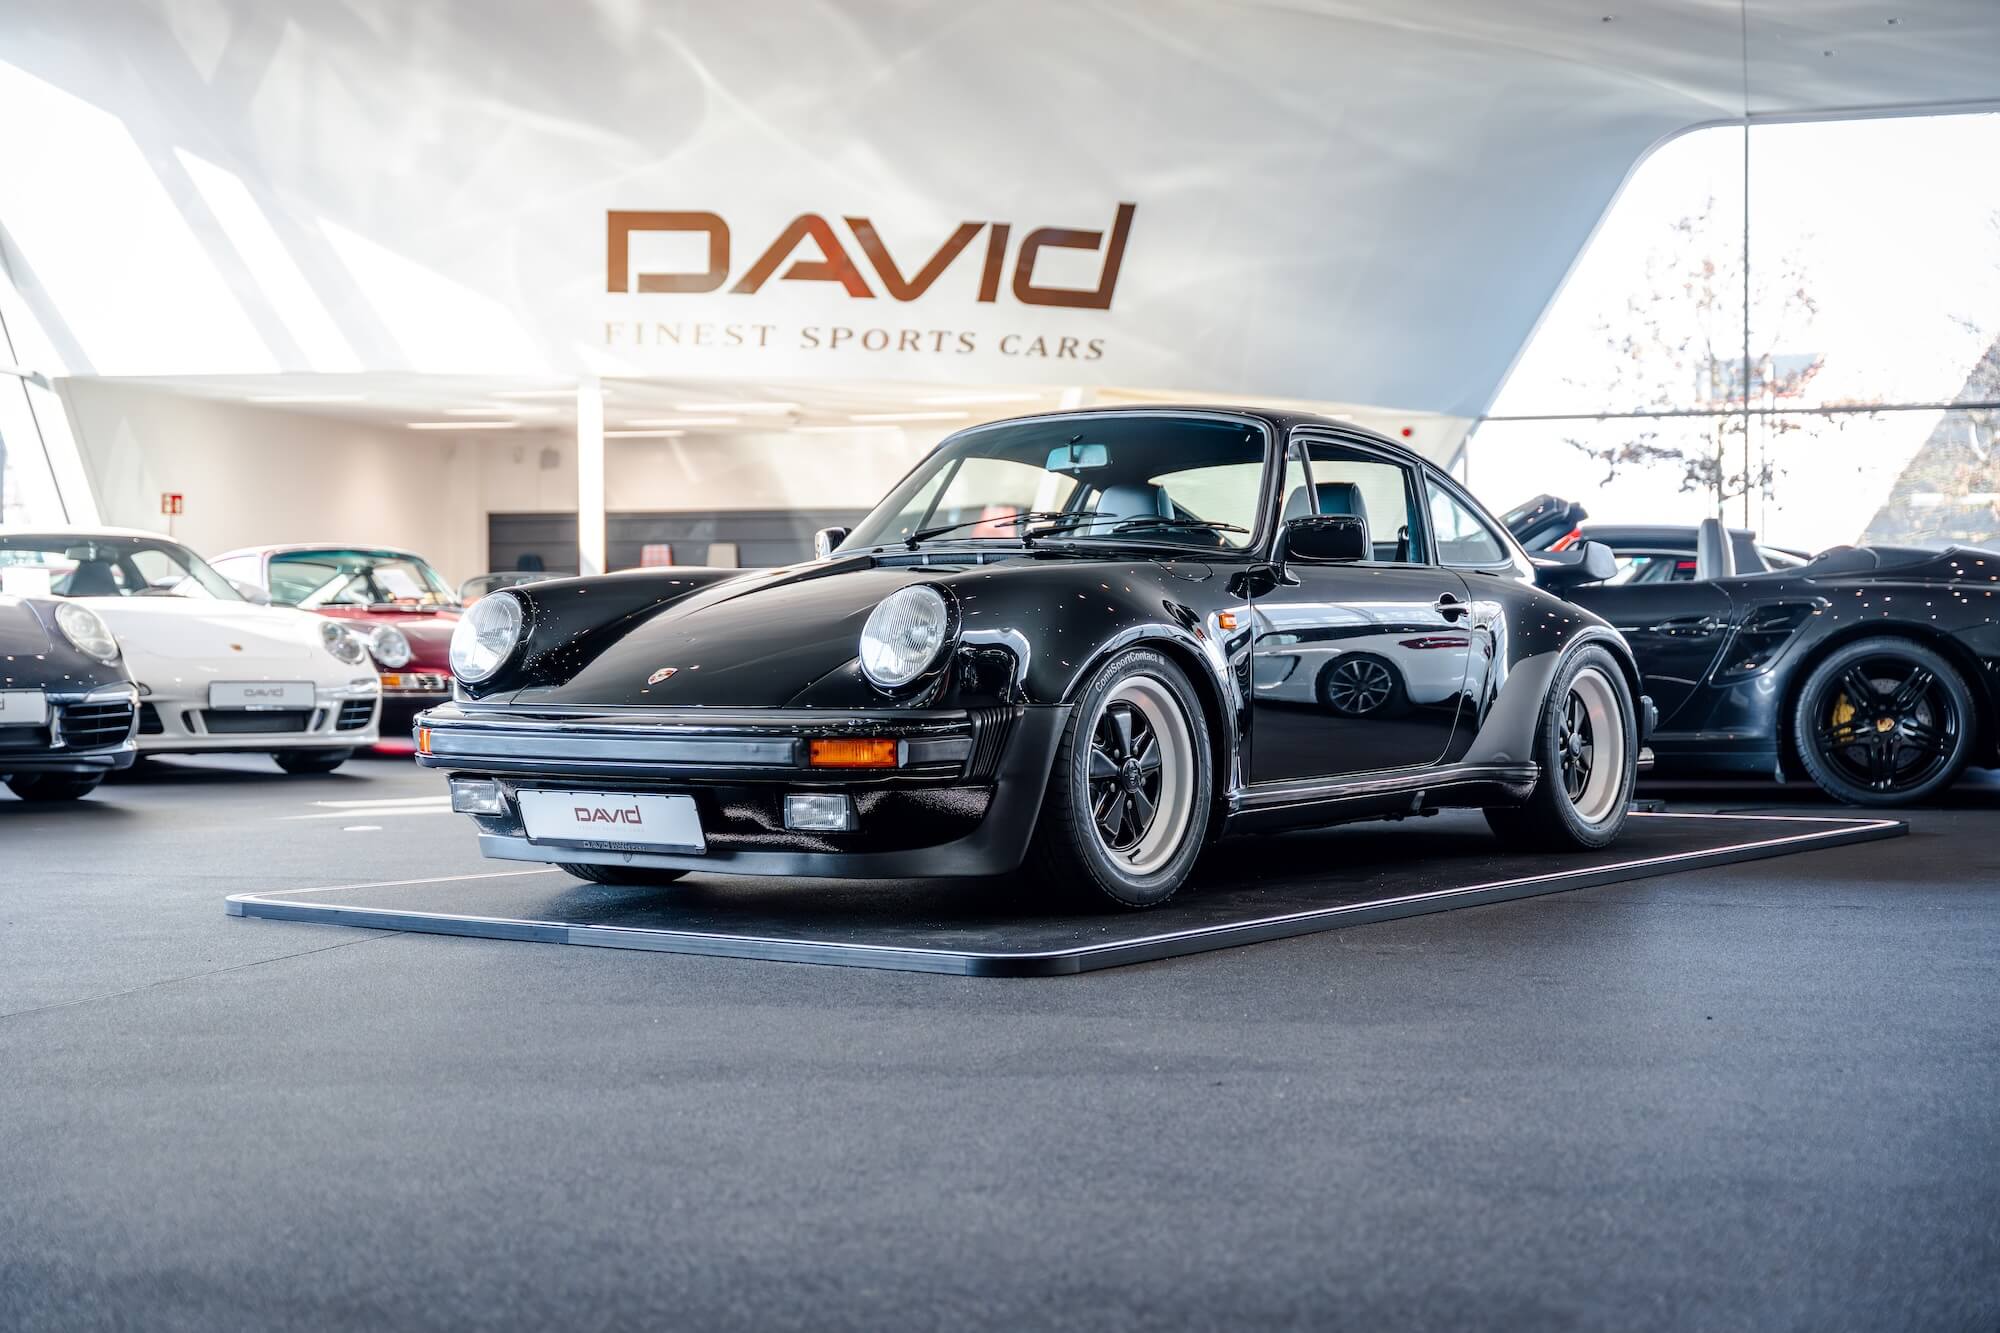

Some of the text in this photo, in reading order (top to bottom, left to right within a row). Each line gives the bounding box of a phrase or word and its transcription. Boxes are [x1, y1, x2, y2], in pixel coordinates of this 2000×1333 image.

[605, 322, 1106, 361] FINEST SPORTS CARS
[1095, 651, 1158, 692] ContiSportContact
